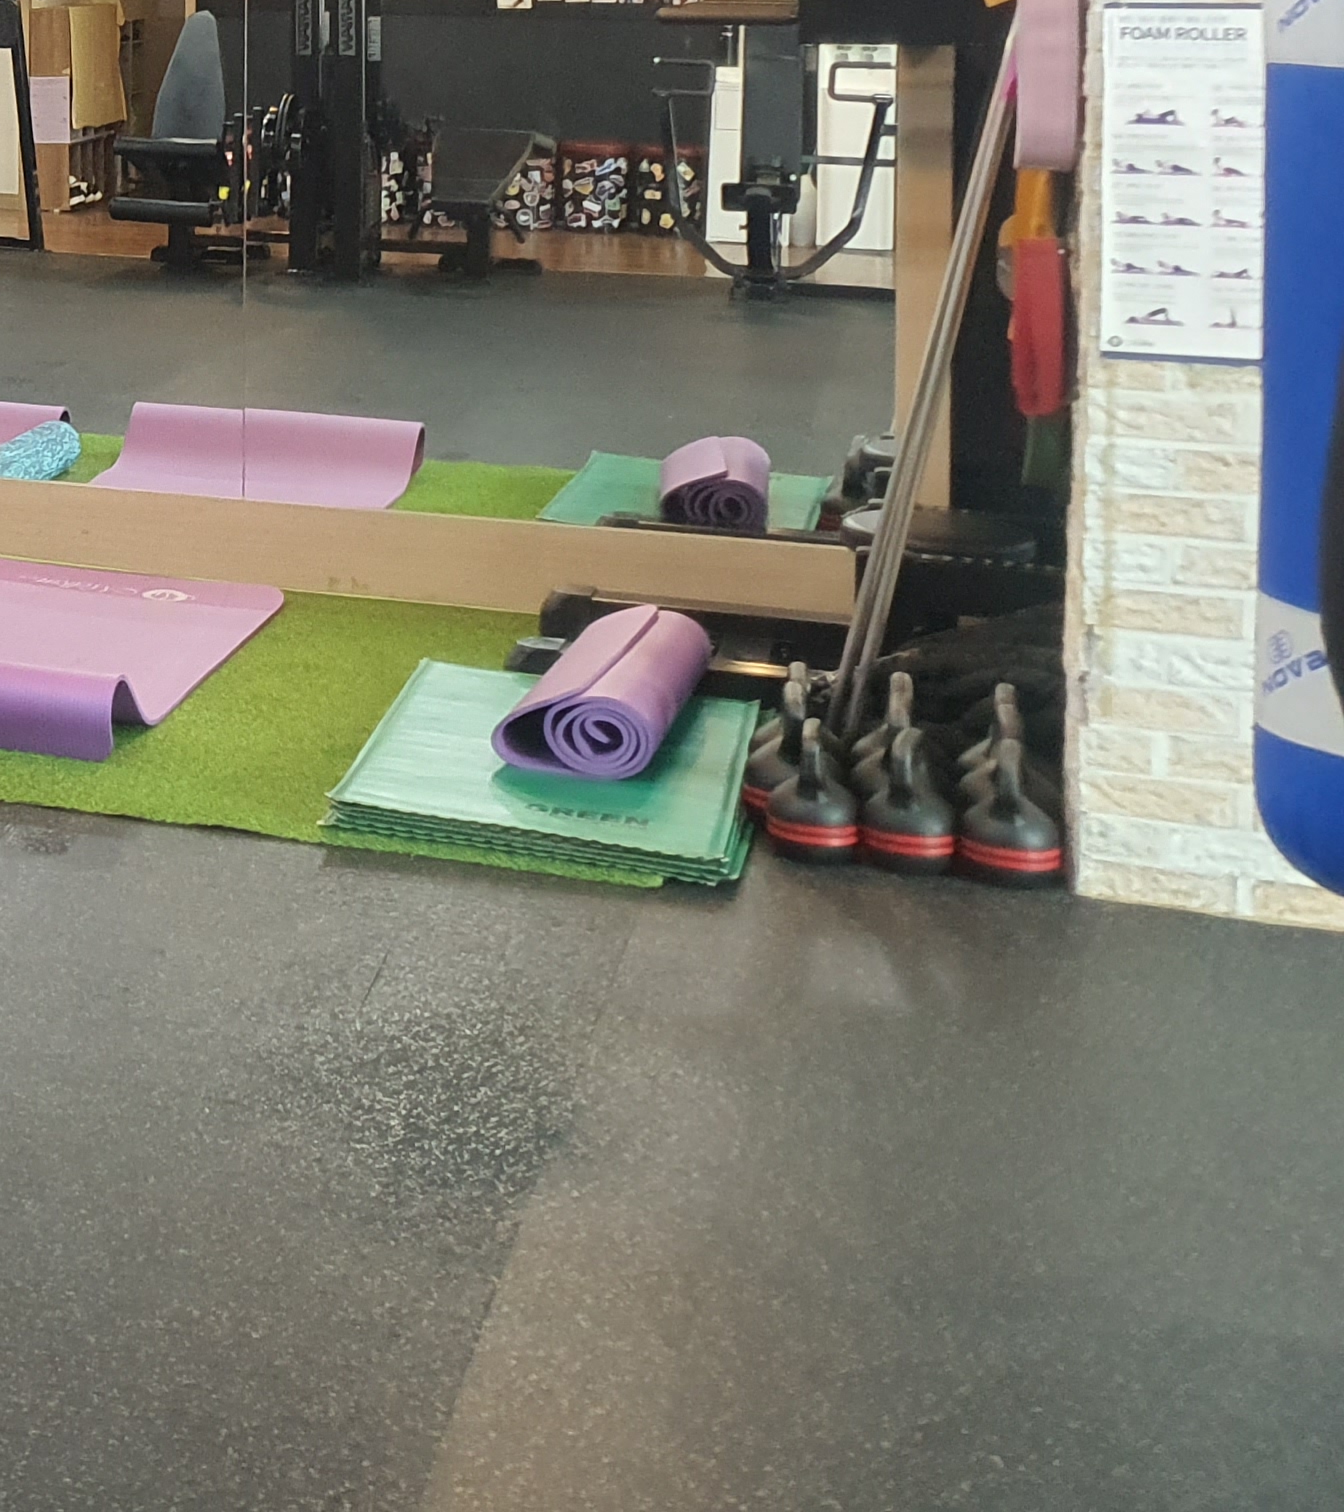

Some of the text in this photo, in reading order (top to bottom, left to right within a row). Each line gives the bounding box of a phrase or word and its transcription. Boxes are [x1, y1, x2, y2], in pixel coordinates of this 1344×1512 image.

[1119, 25, 1248, 42] FOAM ROLLER
[525, 803, 650, 829] GREEN
